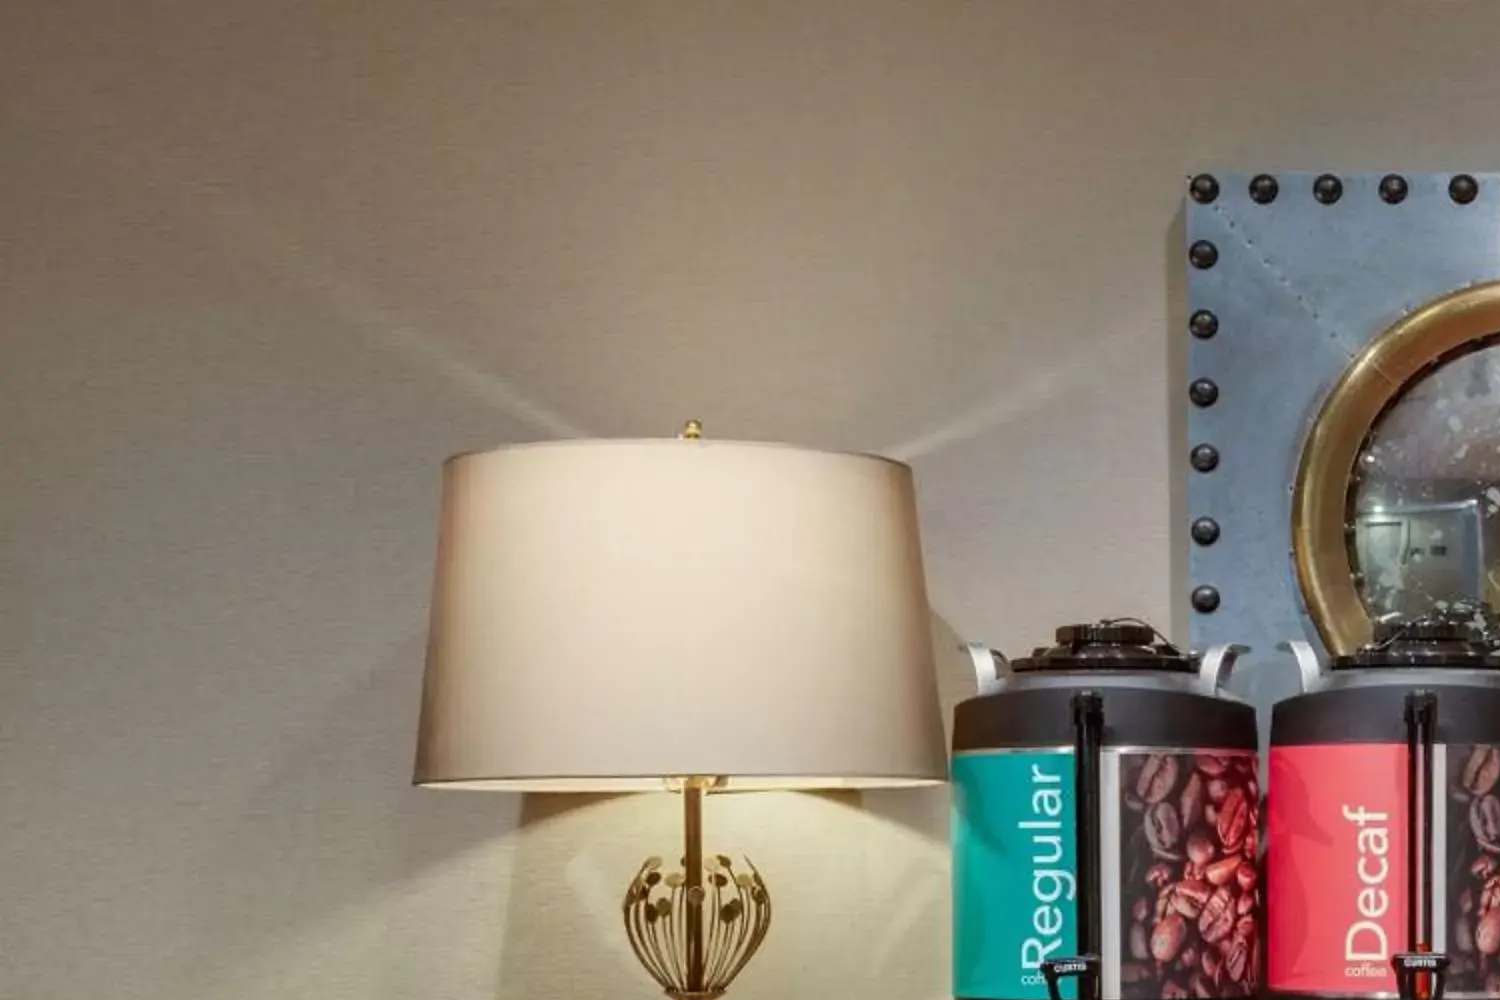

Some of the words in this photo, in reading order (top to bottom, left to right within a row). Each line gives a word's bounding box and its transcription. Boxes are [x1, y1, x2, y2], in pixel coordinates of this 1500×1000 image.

[1017, 763, 1077, 969] Regular
[1341, 803, 1389, 961] Decaf
[1344, 963, 1388, 978] coffee
